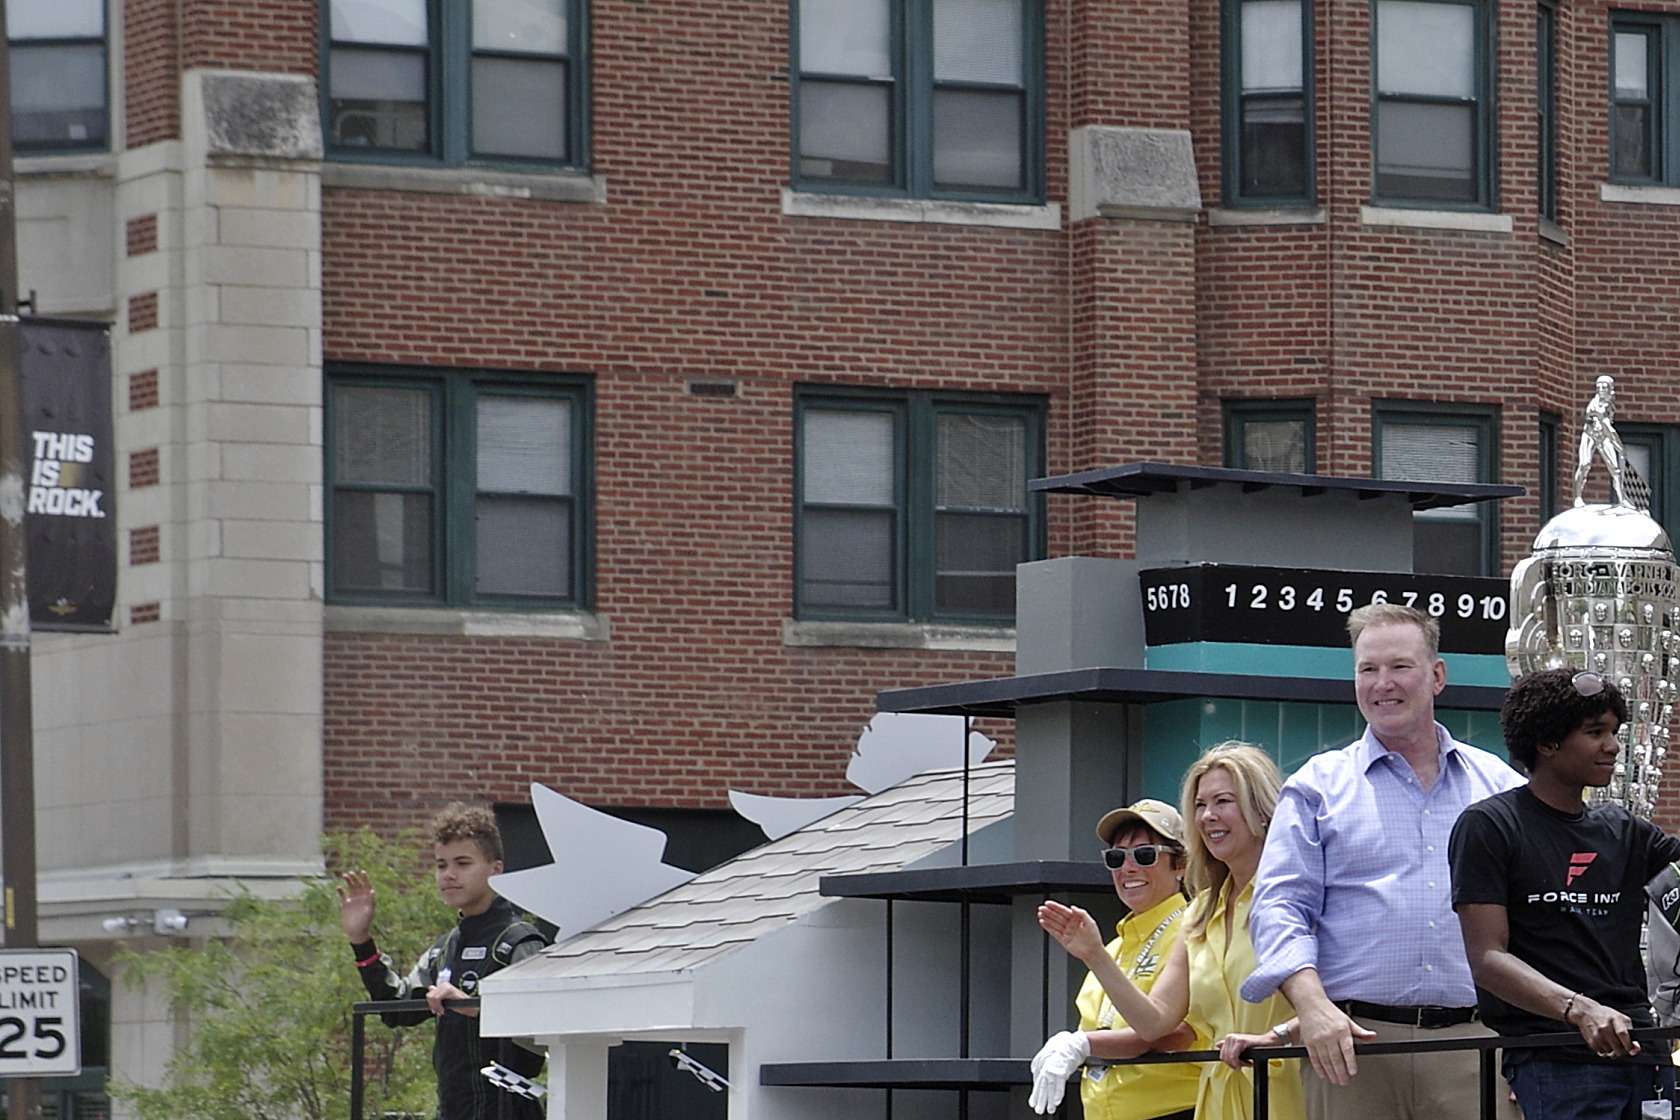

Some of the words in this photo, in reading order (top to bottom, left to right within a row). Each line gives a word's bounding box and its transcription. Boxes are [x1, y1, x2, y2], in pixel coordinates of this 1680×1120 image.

[32, 431, 94, 462] THIS
[32, 459, 60, 487] IS
[28, 486, 105, 518] ROCK.
[1147, 584, 1190, 611] 5678
[1225, 584, 1237, 607] 1
[1250, 585, 1267, 608] 2
[1278, 586, 1296, 610] 3
[1306, 588, 1324, 611] 4
[1335, 589, 1353, 613] 5
[1371, 590, 1388, 605] 6
[1402, 592, 1418, 607] 7
[1428, 593, 1445, 617] 8
[1457, 594, 1474, 618] 9
[1479, 595, 1506, 621] 10
[1527, 891, 1587, 904] FORCE
[0, 966, 67, 984] PEED
[0, 991, 58, 1008] LIMIT
[0, 1017, 66, 1059] 25
